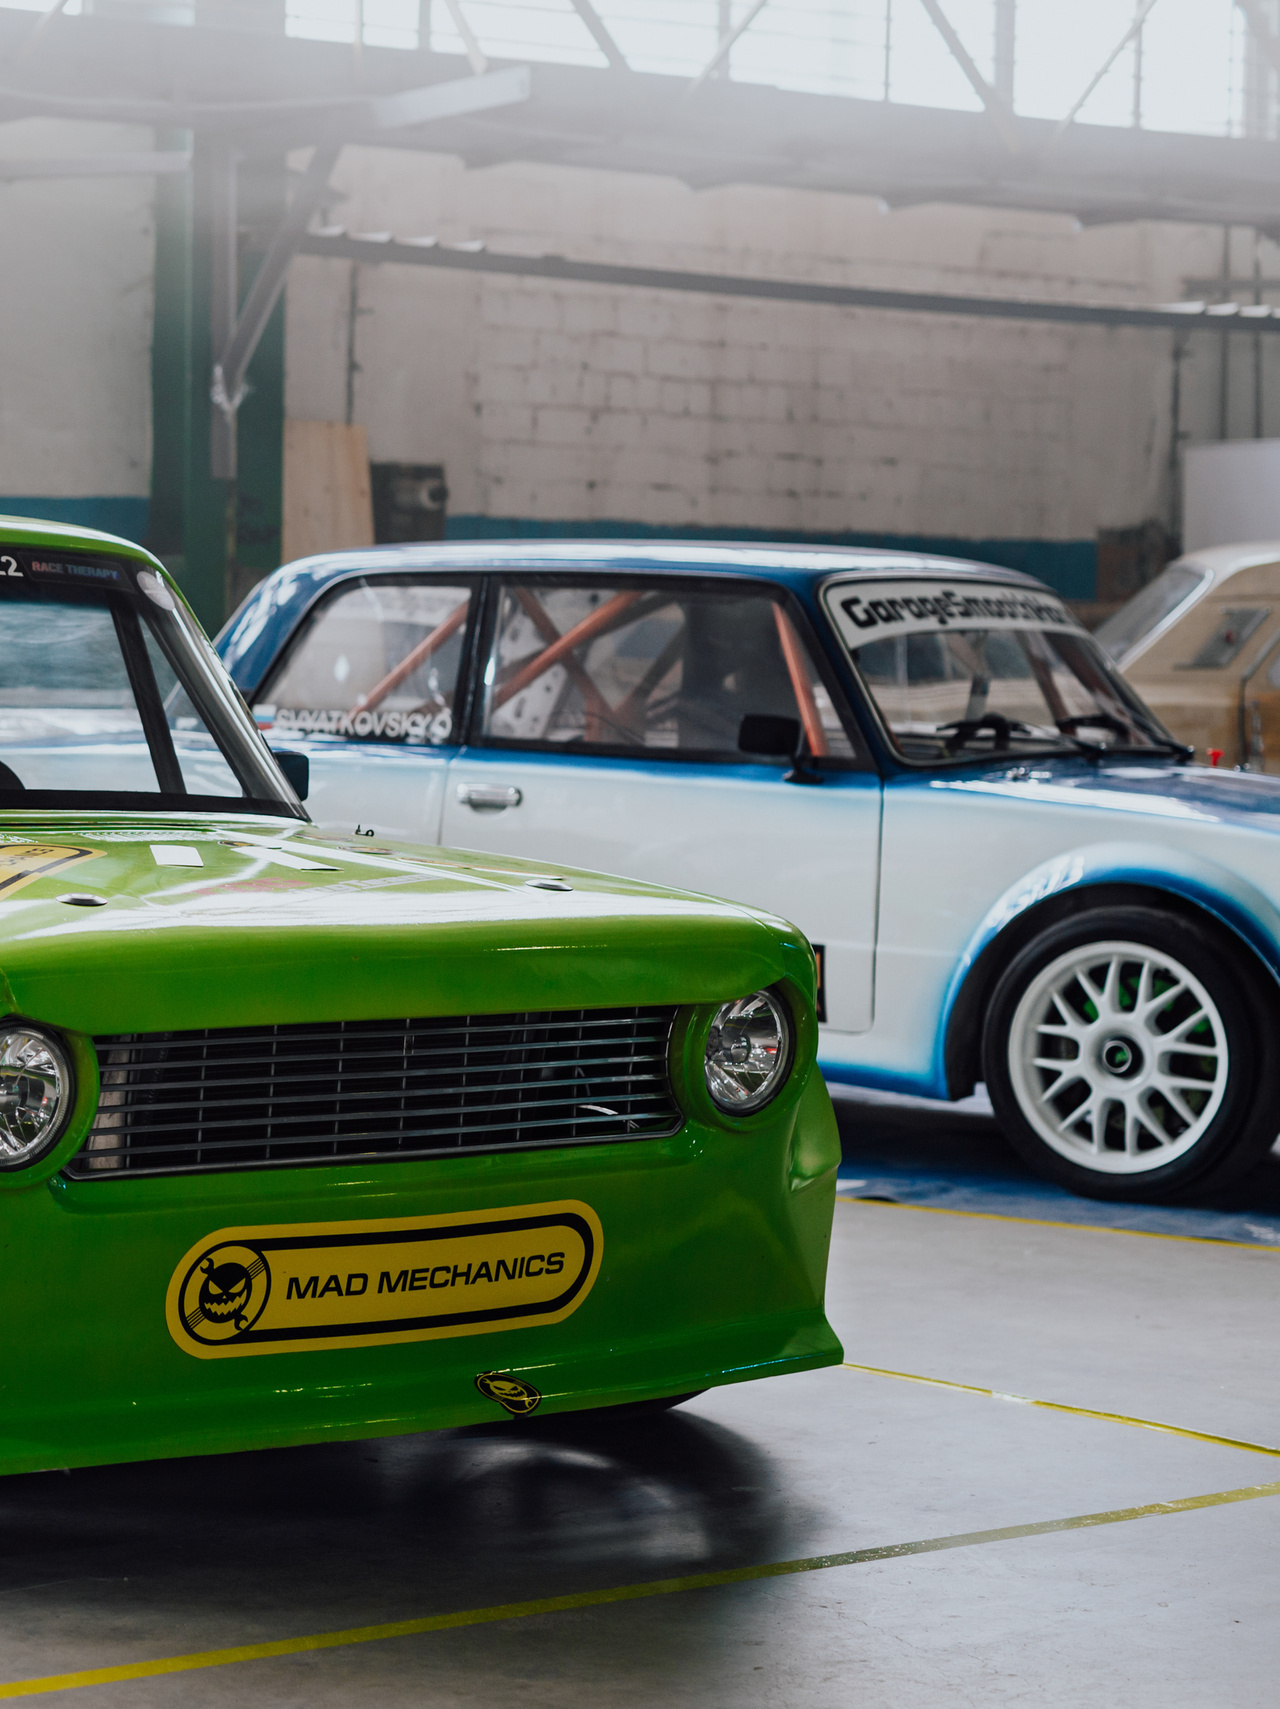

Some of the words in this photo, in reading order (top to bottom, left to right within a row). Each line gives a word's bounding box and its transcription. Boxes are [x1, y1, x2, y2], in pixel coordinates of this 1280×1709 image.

[32, 561, 63, 574] RACE
[65, 564, 120, 580] THERAPY
[286, 1272, 369, 1301] MAD
[377, 1251, 566, 1295] MECHANICS
